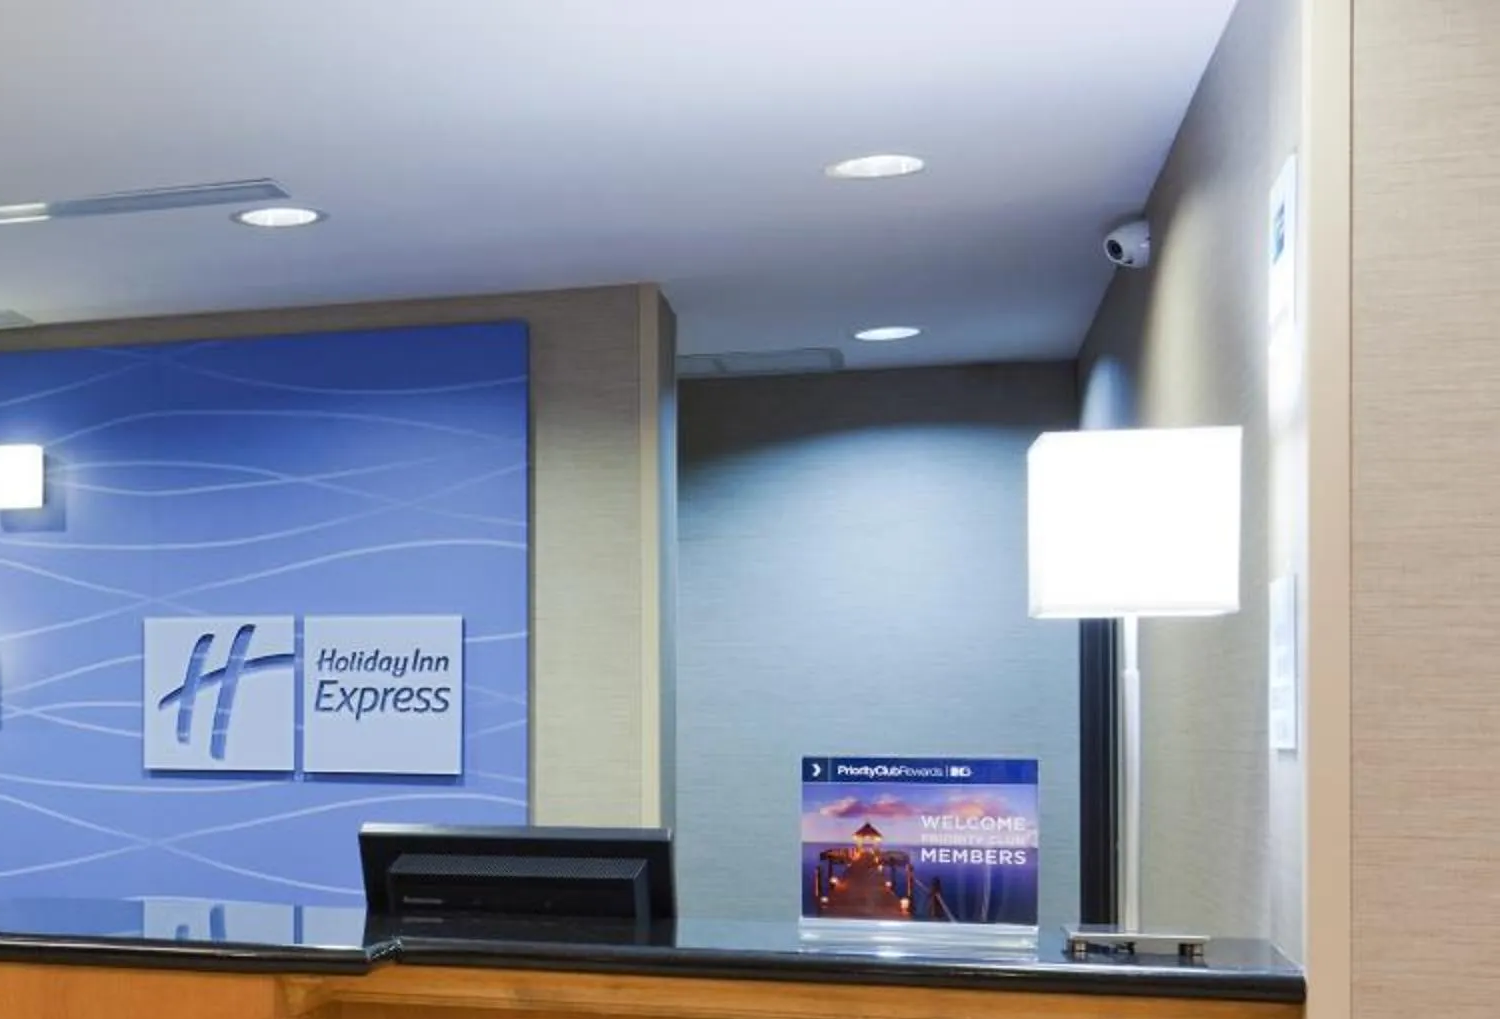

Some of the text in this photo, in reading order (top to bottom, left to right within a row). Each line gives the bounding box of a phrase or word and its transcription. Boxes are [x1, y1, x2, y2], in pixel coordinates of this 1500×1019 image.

[317, 648, 449, 677] Holiday Inn
[314, 679, 451, 720] Express
[920, 815, 1027, 831] WELCOME
[921, 847, 1027, 865] MEMBERS
